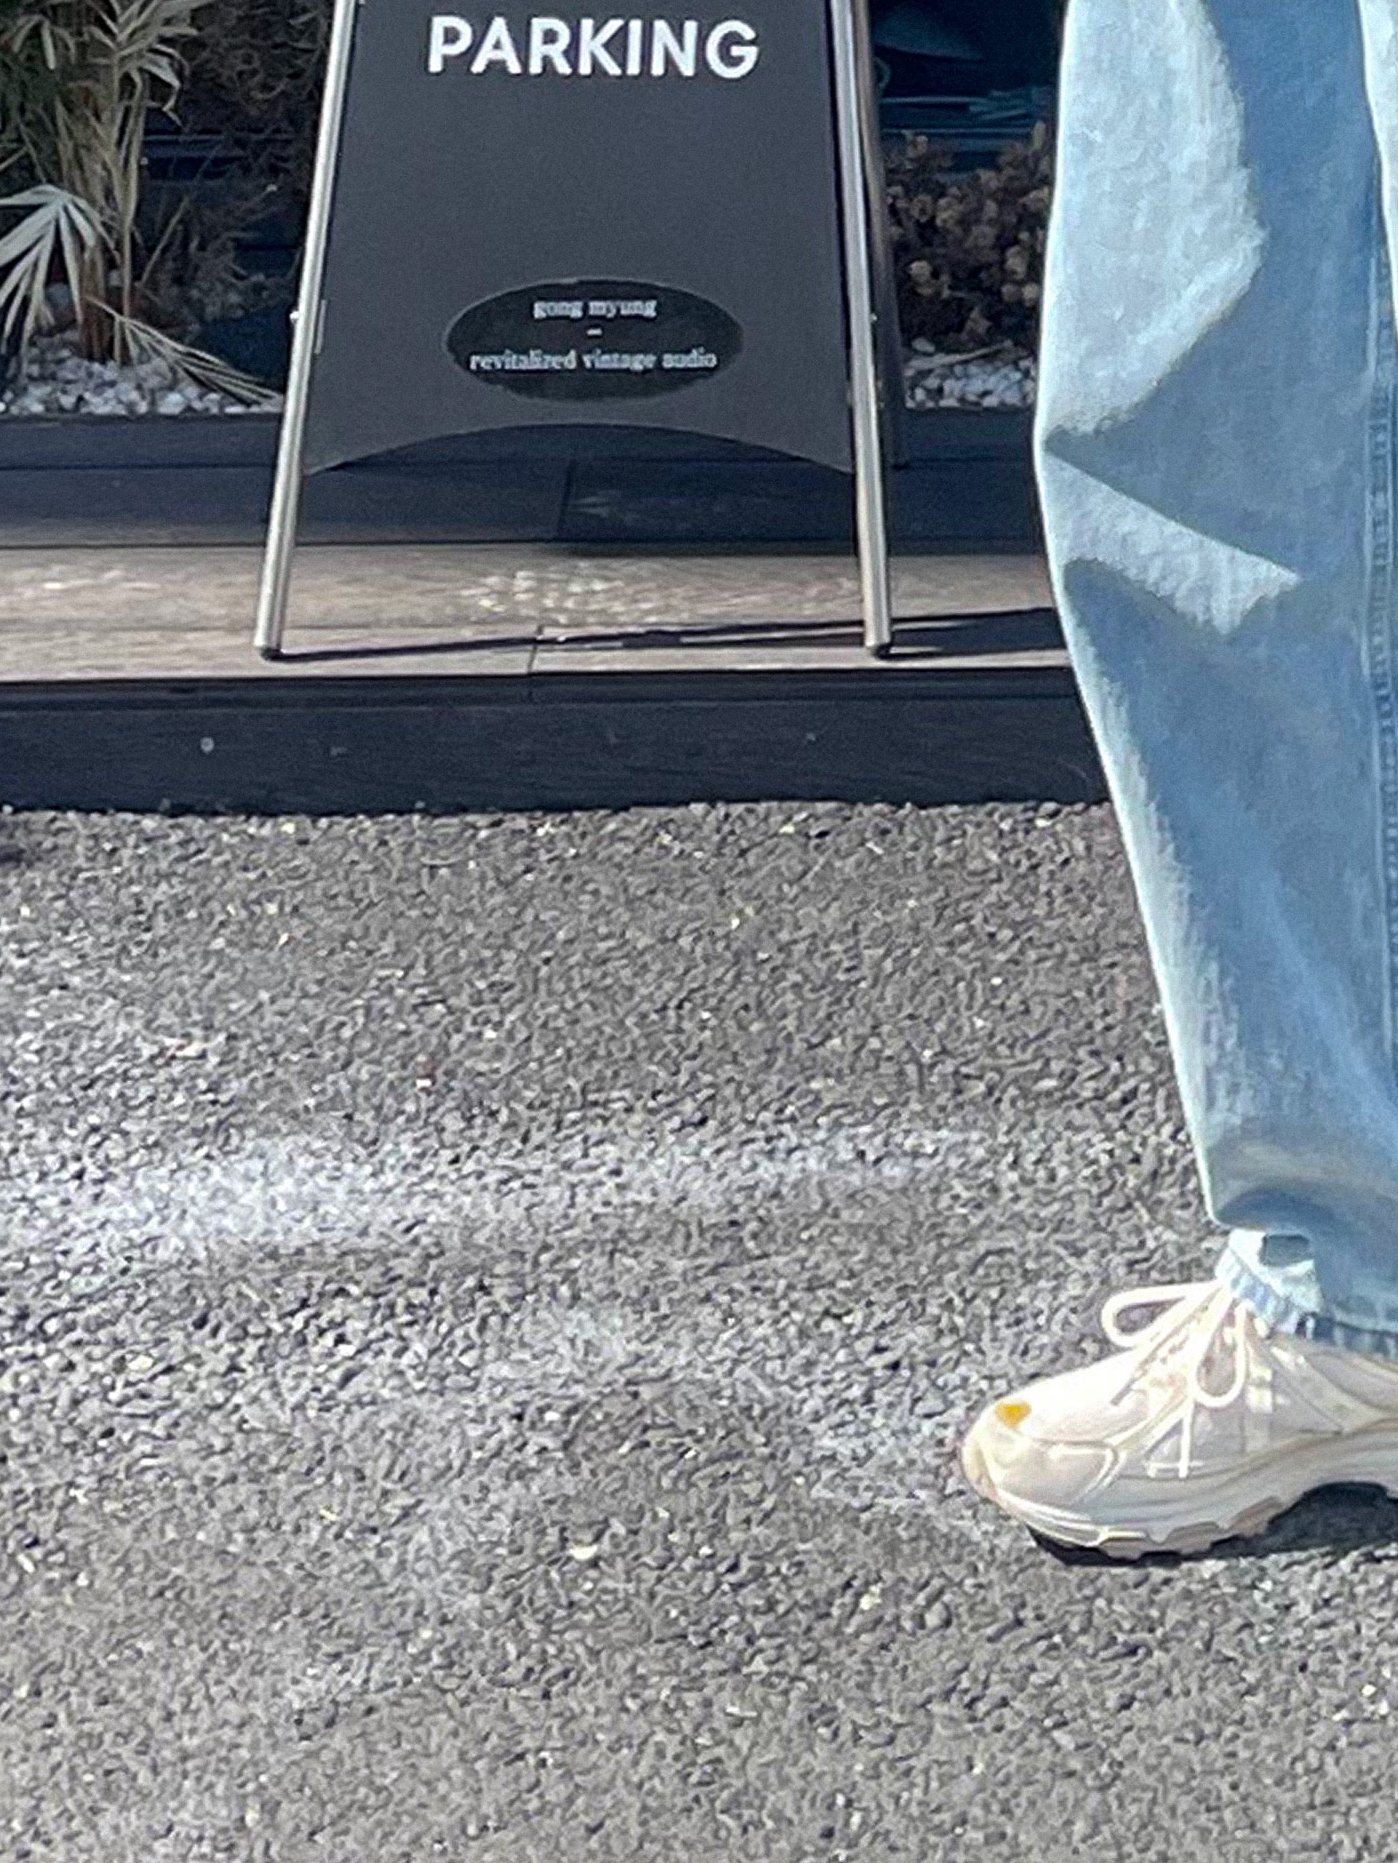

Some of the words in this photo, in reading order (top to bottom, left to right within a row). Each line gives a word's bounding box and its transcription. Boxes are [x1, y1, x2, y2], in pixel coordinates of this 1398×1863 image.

[428, 15, 760, 79] PARKING
[532, 300, 583, 319] gong
[588, 299, 658, 318] myung
[469, 347, 577, 371] revitalized
[582, 347, 657, 371] vintage
[661, 347, 718, 369] audio
